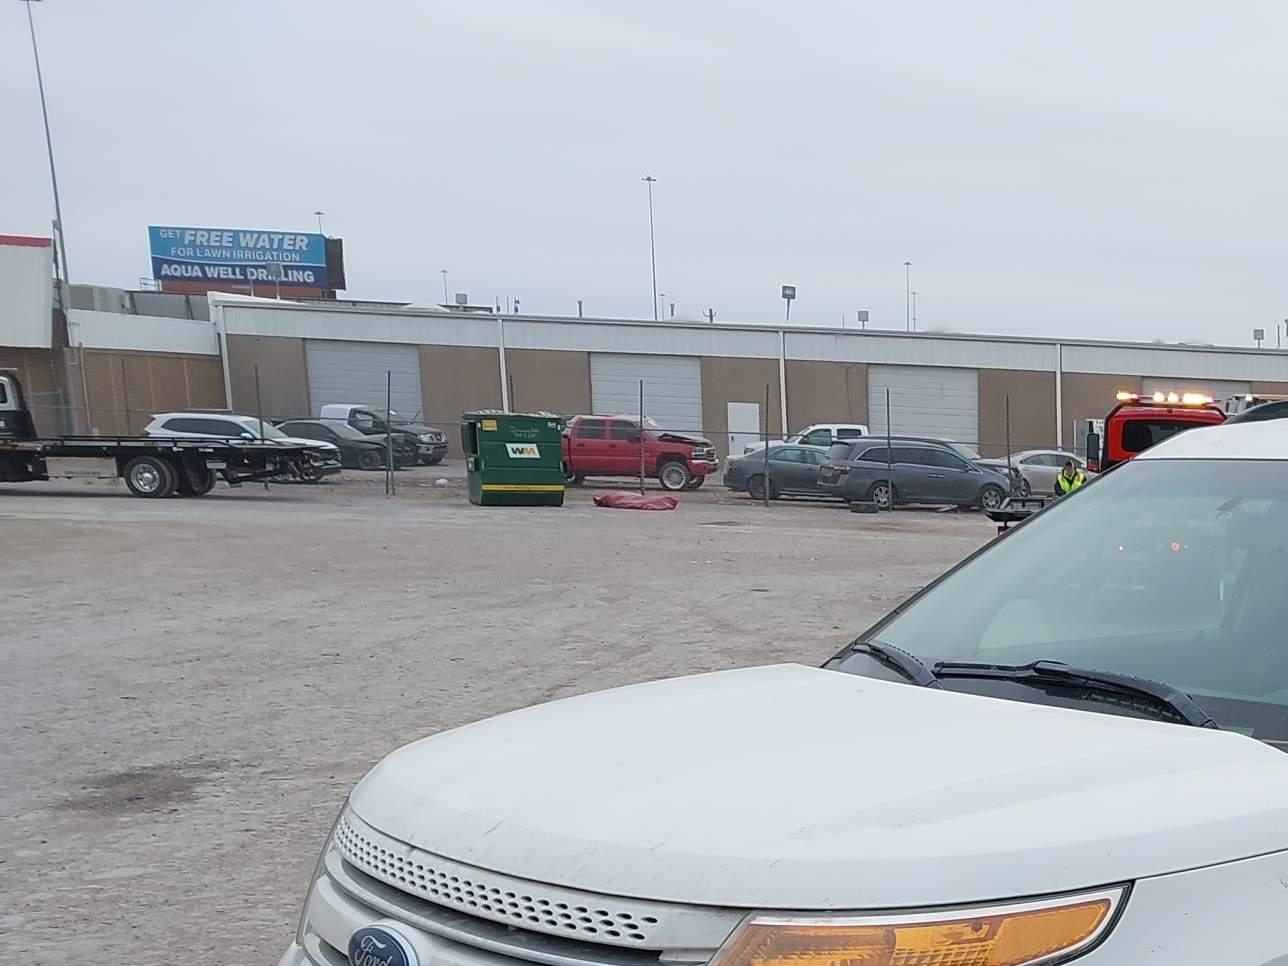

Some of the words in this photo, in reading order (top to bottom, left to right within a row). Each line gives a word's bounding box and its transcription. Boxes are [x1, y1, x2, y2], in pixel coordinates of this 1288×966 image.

[159, 229, 182, 239] GET
[184, 230, 234, 247] FREE
[239, 232, 309, 251] WATER
[171, 247, 194, 258] FOR
[197, 248, 231, 260] LAWN
[233, 250, 300, 262] IRRIGATION
[160, 263, 203, 278] AQUA
[205, 266, 245, 280] WELL
[247, 268, 315, 283] DRLING
